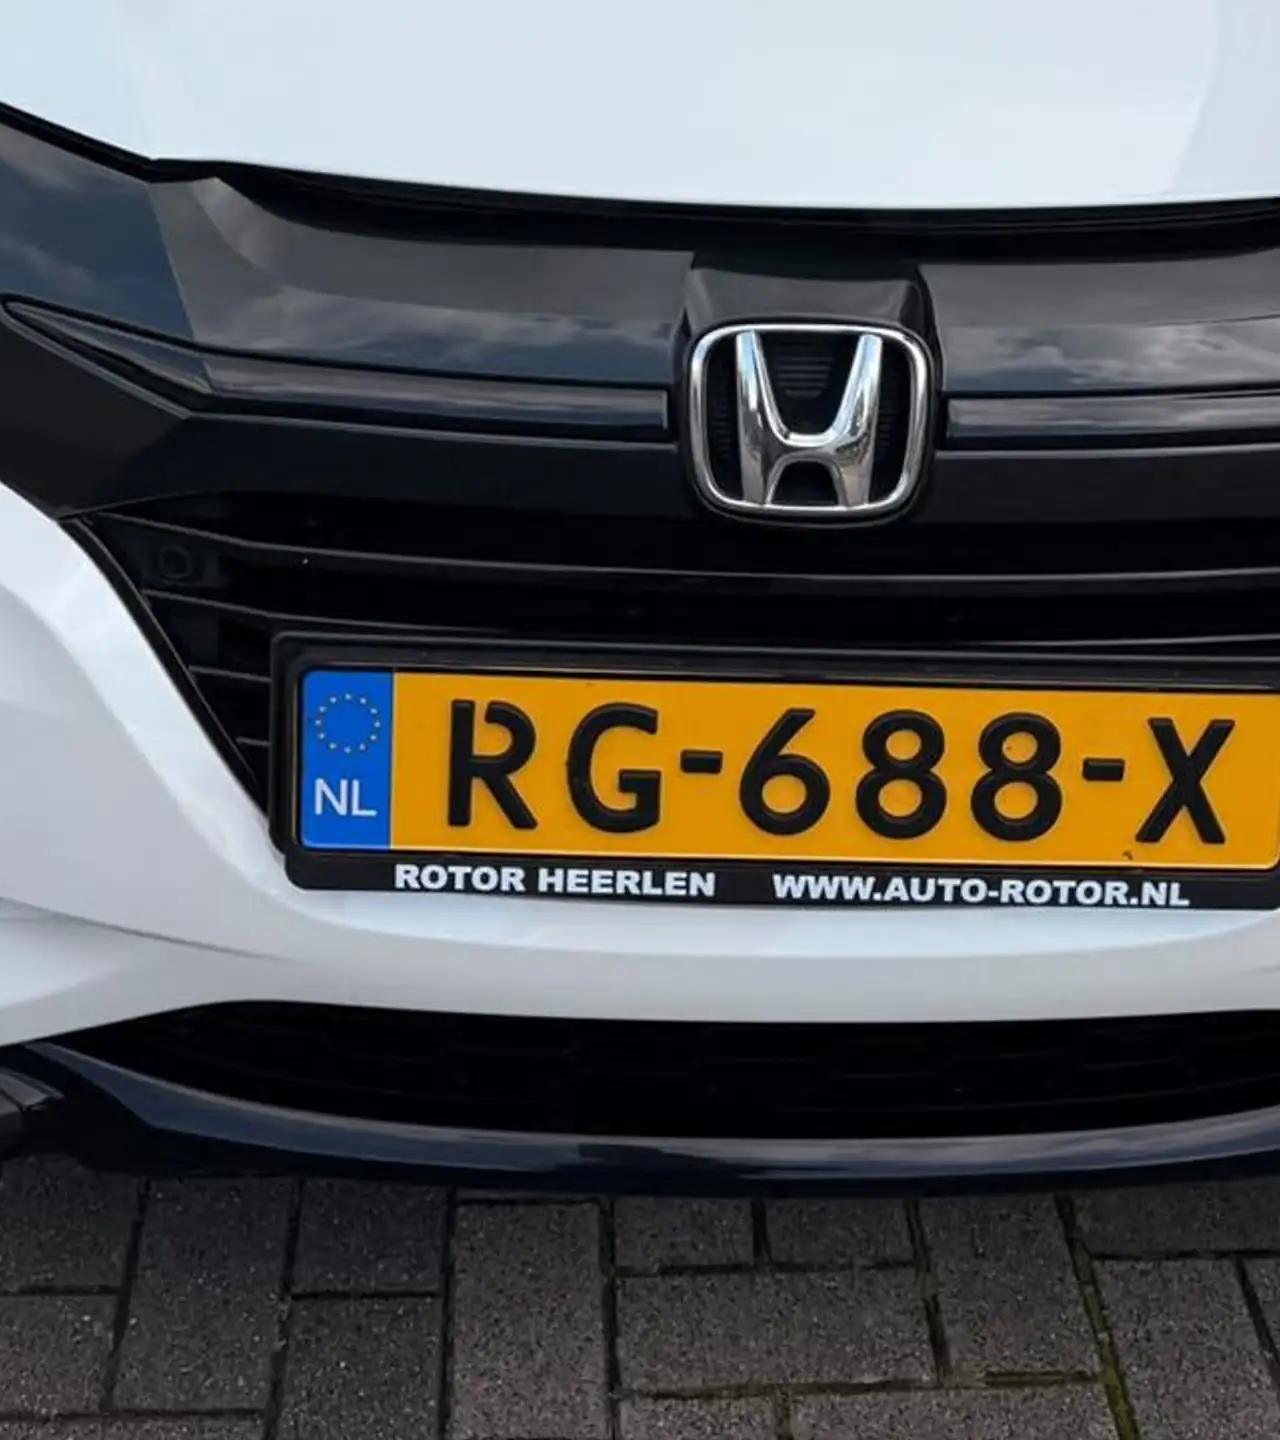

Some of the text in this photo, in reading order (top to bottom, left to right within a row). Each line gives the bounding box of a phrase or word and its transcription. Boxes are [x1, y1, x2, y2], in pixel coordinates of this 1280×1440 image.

[447, 697, 1236, 846] RG-688-X
[314, 778, 377, 817] NL
[395, 864, 1191, 907] ROTOR HEERLEN WWW.AUTO-ROTOR.NL
